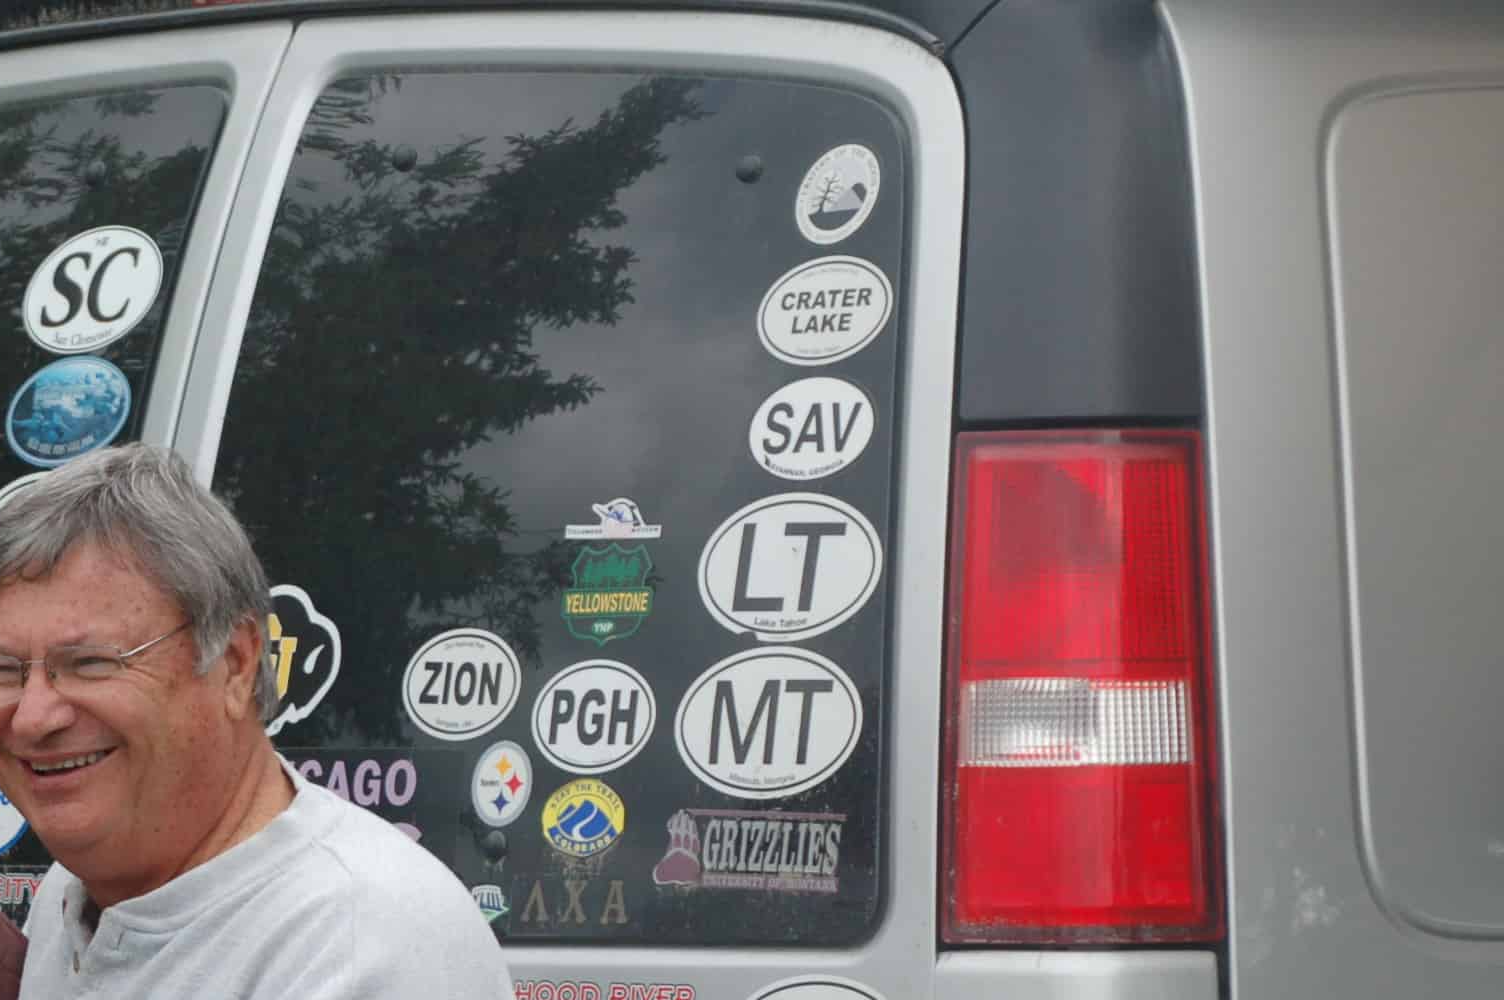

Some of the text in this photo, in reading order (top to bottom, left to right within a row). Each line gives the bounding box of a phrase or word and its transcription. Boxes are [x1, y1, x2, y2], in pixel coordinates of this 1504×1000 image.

[40, 246, 141, 328] SC
[781, 288, 872, 311] CRATER
[791, 313, 853, 334] LAKE
[762, 402, 863, 455] SAV
[731, 522, 847, 612] LT
[566, 592, 649, 615] YELLOWSTONE
[418, 661, 503, 706] ZION
[548, 688, 639, 746] PGH
[708, 680, 834, 765] MT
[576, 783, 593, 794] THE
[703, 819, 842, 875] GRIZZLIES
